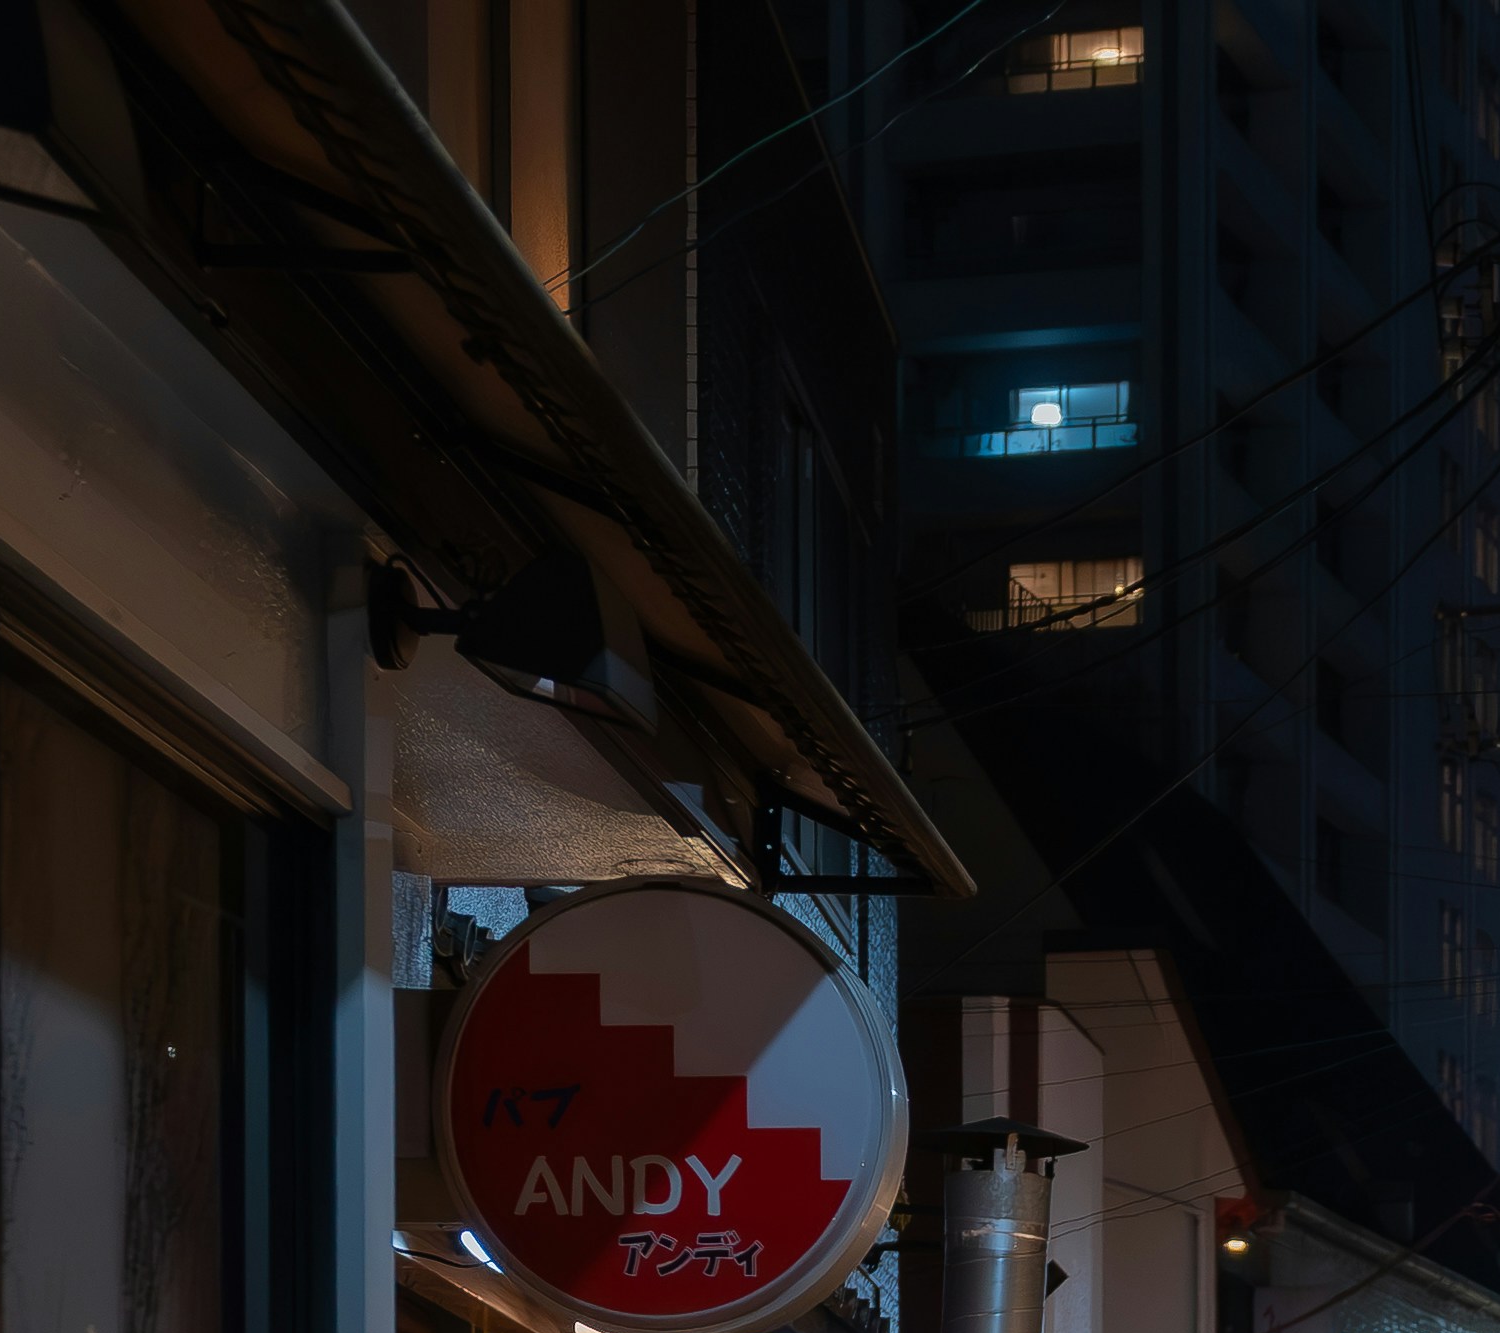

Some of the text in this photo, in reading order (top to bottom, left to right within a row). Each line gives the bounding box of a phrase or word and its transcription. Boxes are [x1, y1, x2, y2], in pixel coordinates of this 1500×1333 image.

[514, 1154, 742, 1217] ANDY
[618, 1230, 761, 1278] アンディ
